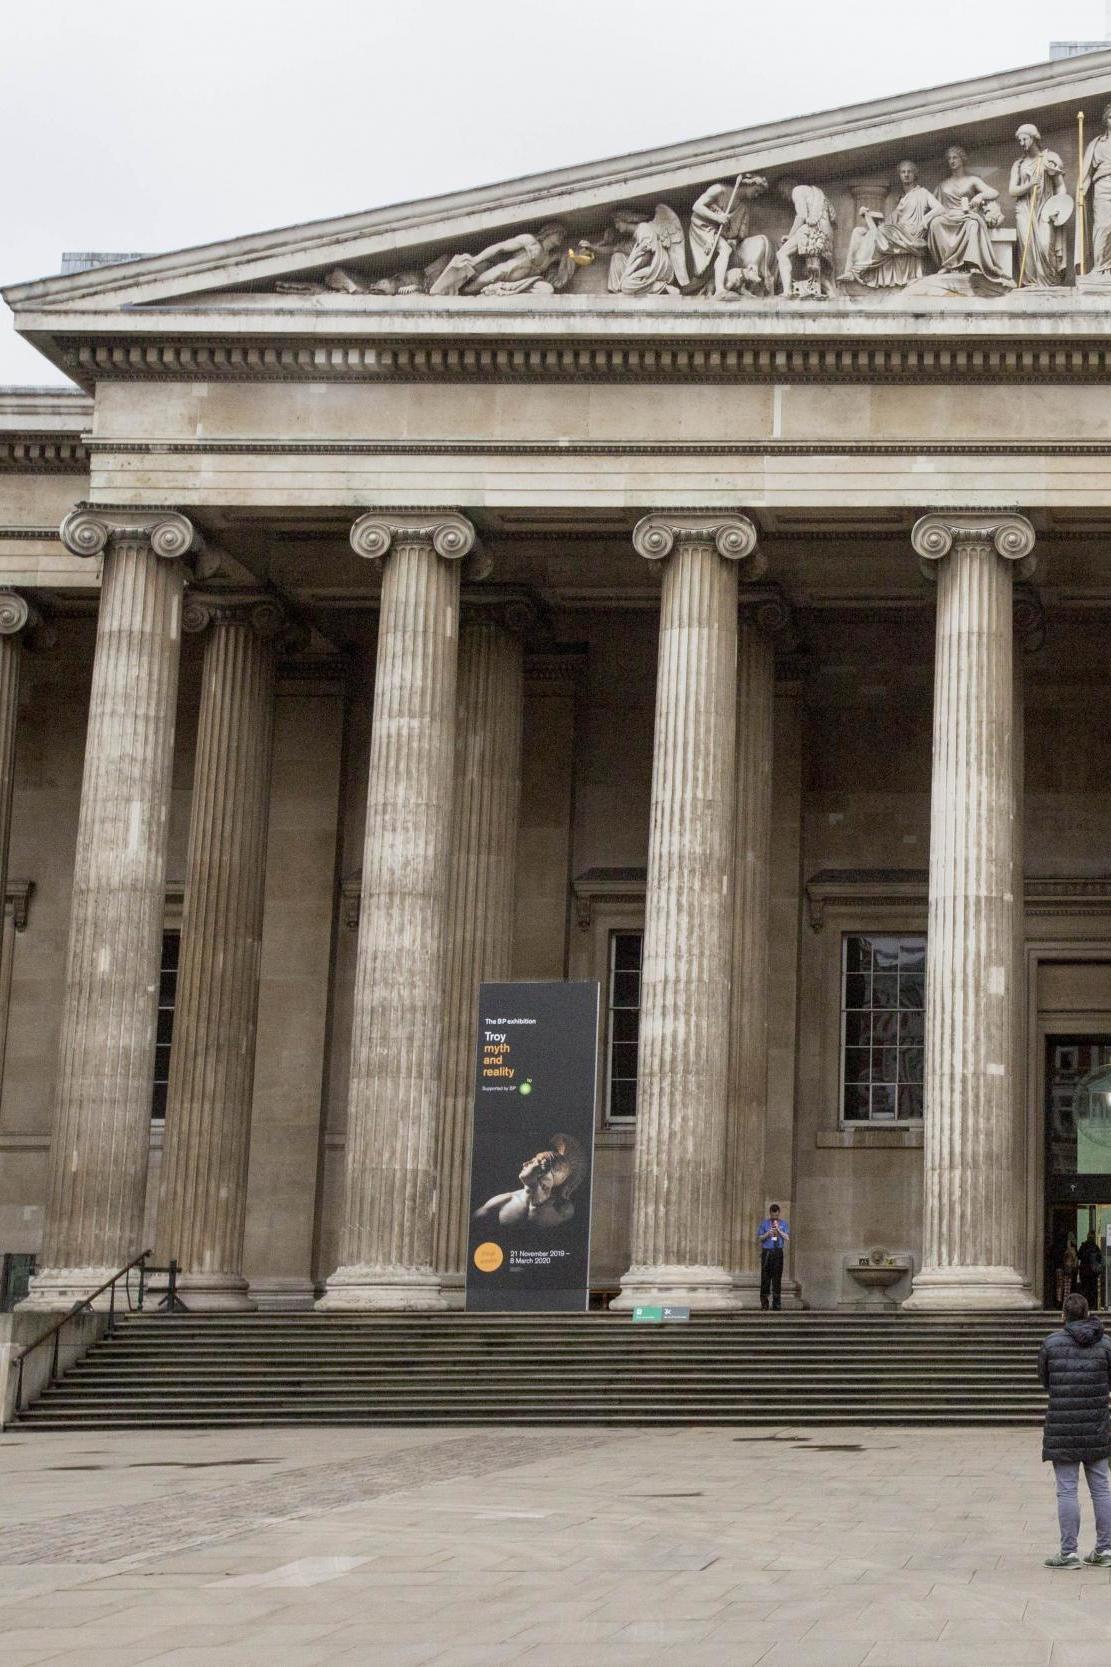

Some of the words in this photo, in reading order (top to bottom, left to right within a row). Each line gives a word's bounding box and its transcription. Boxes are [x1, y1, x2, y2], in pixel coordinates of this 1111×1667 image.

[485, 1031, 506, 1043] Troy
[484, 1043, 510, 1055] myth
[483, 1055, 502, 1065] and
[483, 1067, 514, 1078] reality
